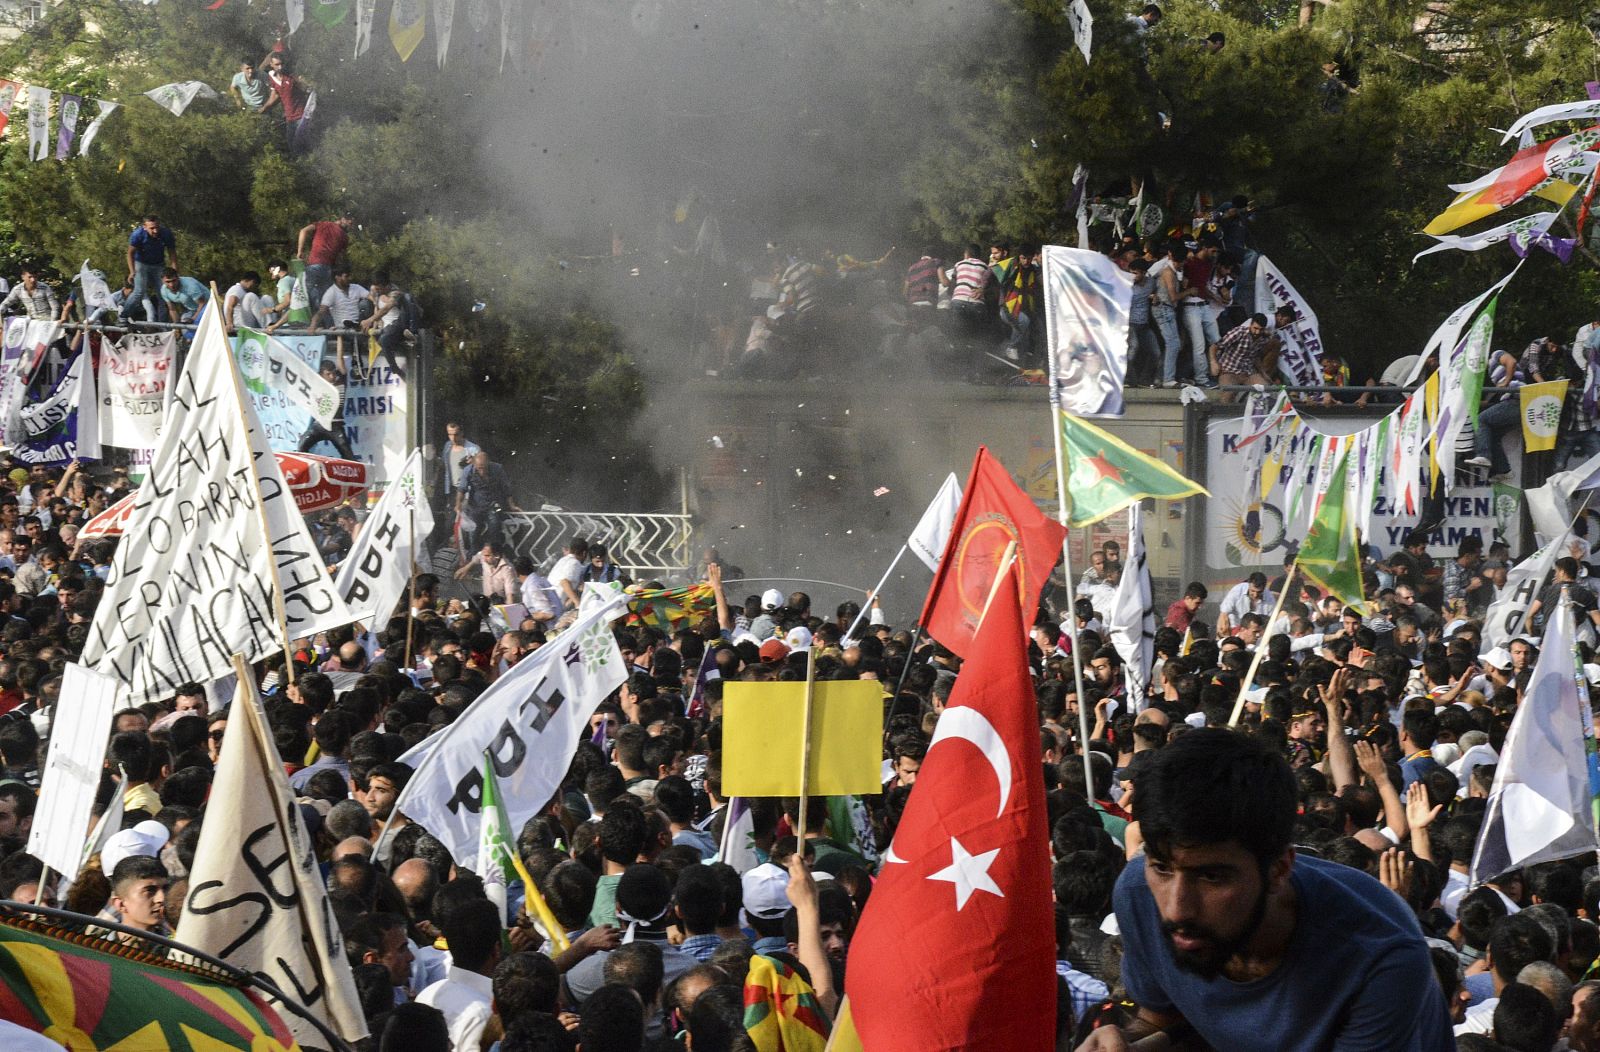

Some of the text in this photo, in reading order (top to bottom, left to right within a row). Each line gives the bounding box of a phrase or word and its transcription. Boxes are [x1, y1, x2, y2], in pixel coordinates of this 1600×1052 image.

[344, 511, 401, 606] HDP
[1385, 526, 1484, 547] YAAMA
[446, 675, 566, 816] HDP
